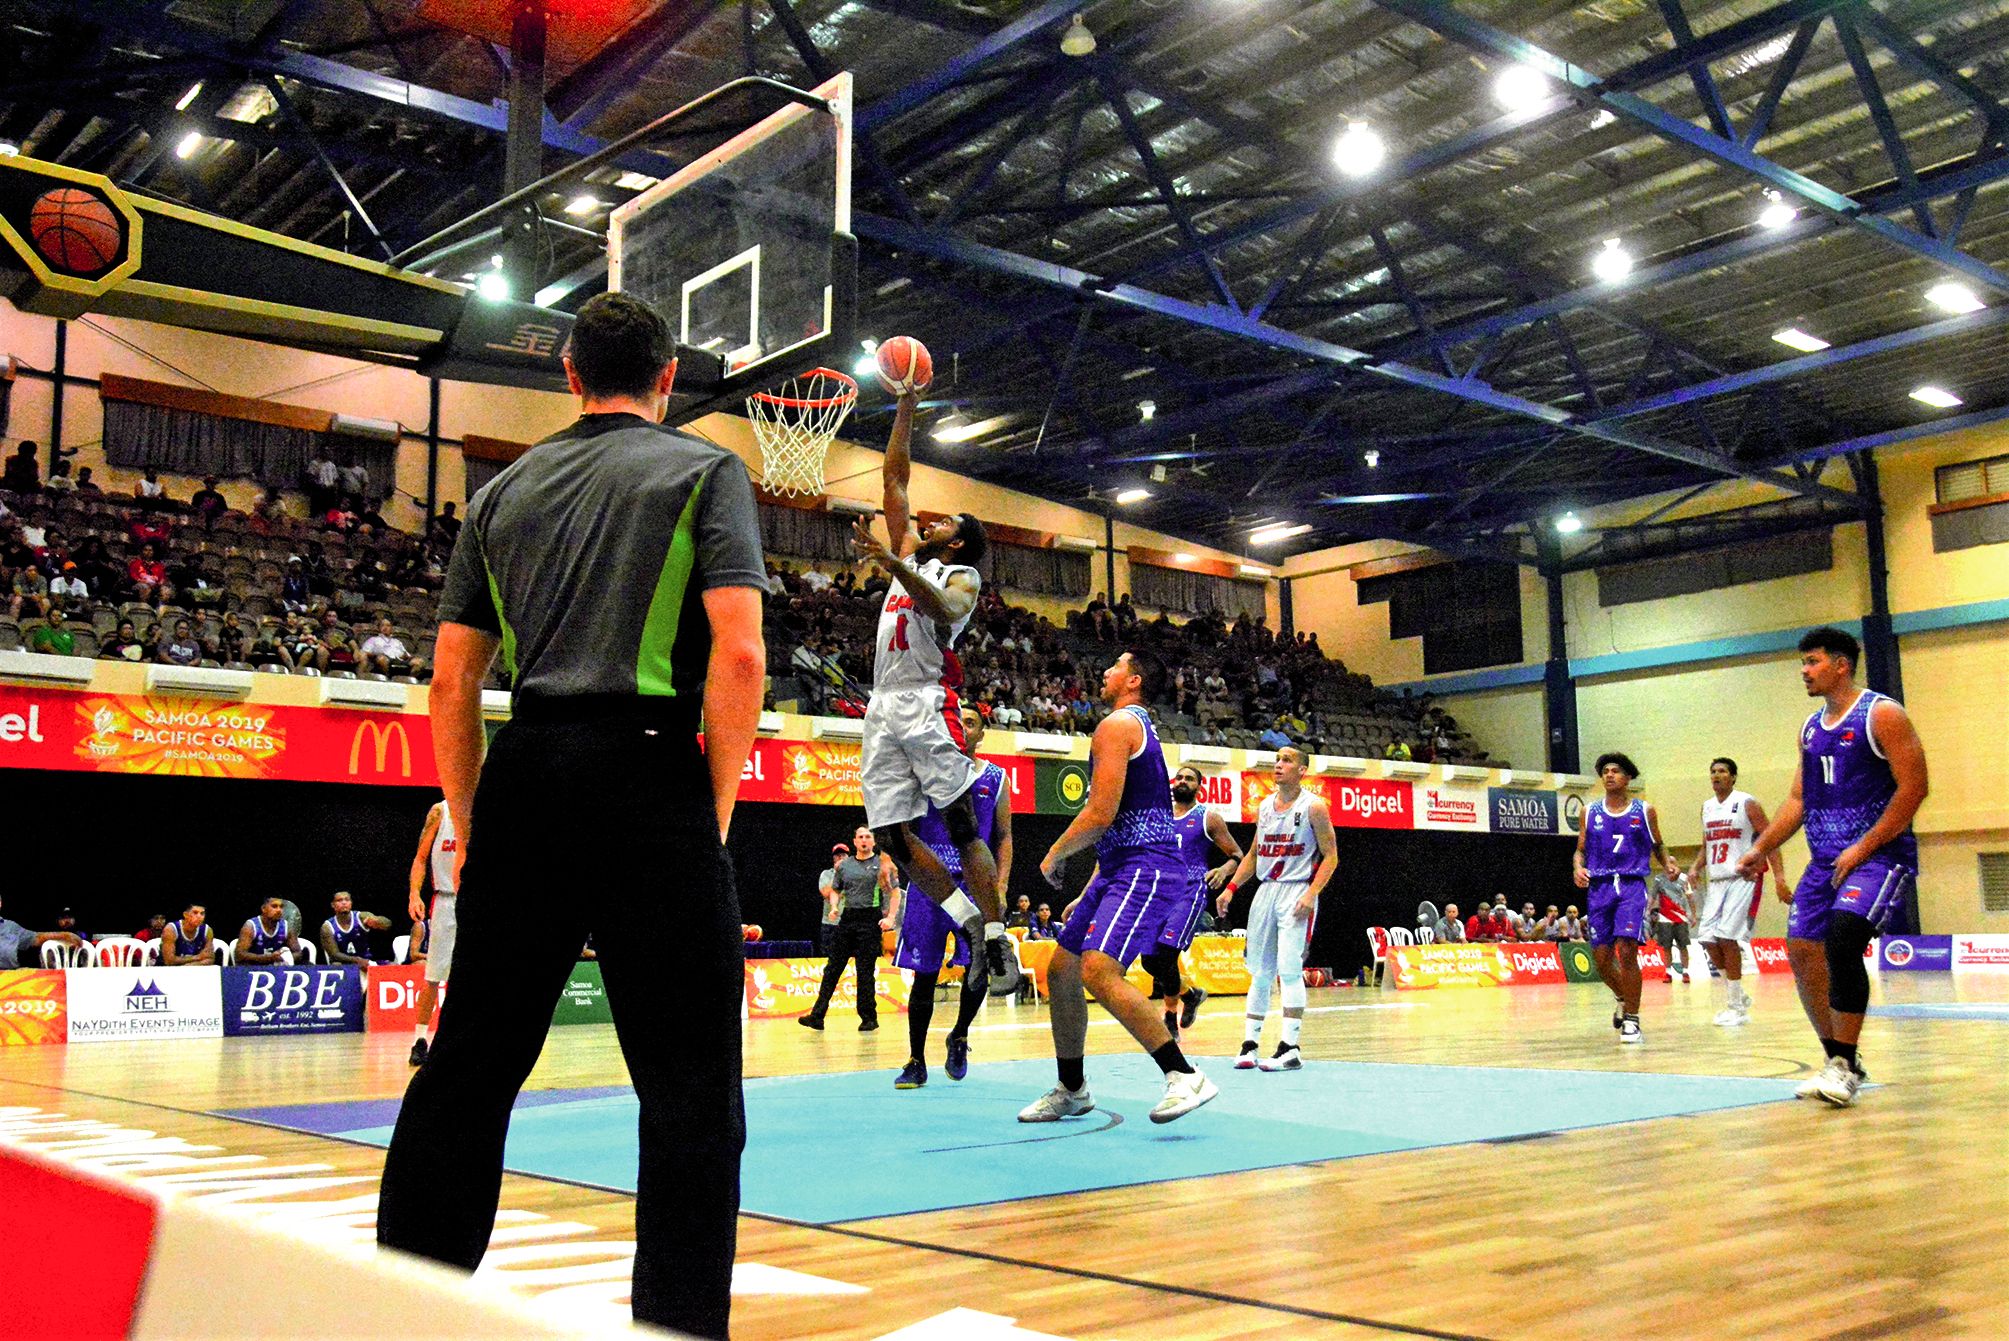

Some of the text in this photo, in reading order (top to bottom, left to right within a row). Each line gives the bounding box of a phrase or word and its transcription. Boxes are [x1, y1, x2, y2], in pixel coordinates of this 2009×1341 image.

[144, 709, 265, 732] SAMOA 2019
[133, 728, 274, 750] PACIFIC GAMES
[165, 749, 244, 763] #SAMOA2019
[1820, 755, 1834, 784] 11
[1065, 782, 1081, 790] SCB
[1341, 787, 1404, 818] Digicel
[1498, 798, 1548, 817] SAMOA
[1499, 816, 1549, 829] PURE WATER
[1612, 834, 1625, 854] 7
[1711, 843, 1729, 864] 13
[1512, 952, 1559, 976] Digicel
[1753, 946, 1788, 965] Digicel
[241, 969, 345, 1010] BBE
[562, 987, 602, 997] Commercial
[570, 981, 593, 989] Samoa
[126, 996, 168, 1010] NEH
[575, 997, 593, 1005] Bank
[296, 1011, 314, 1019] 1992
